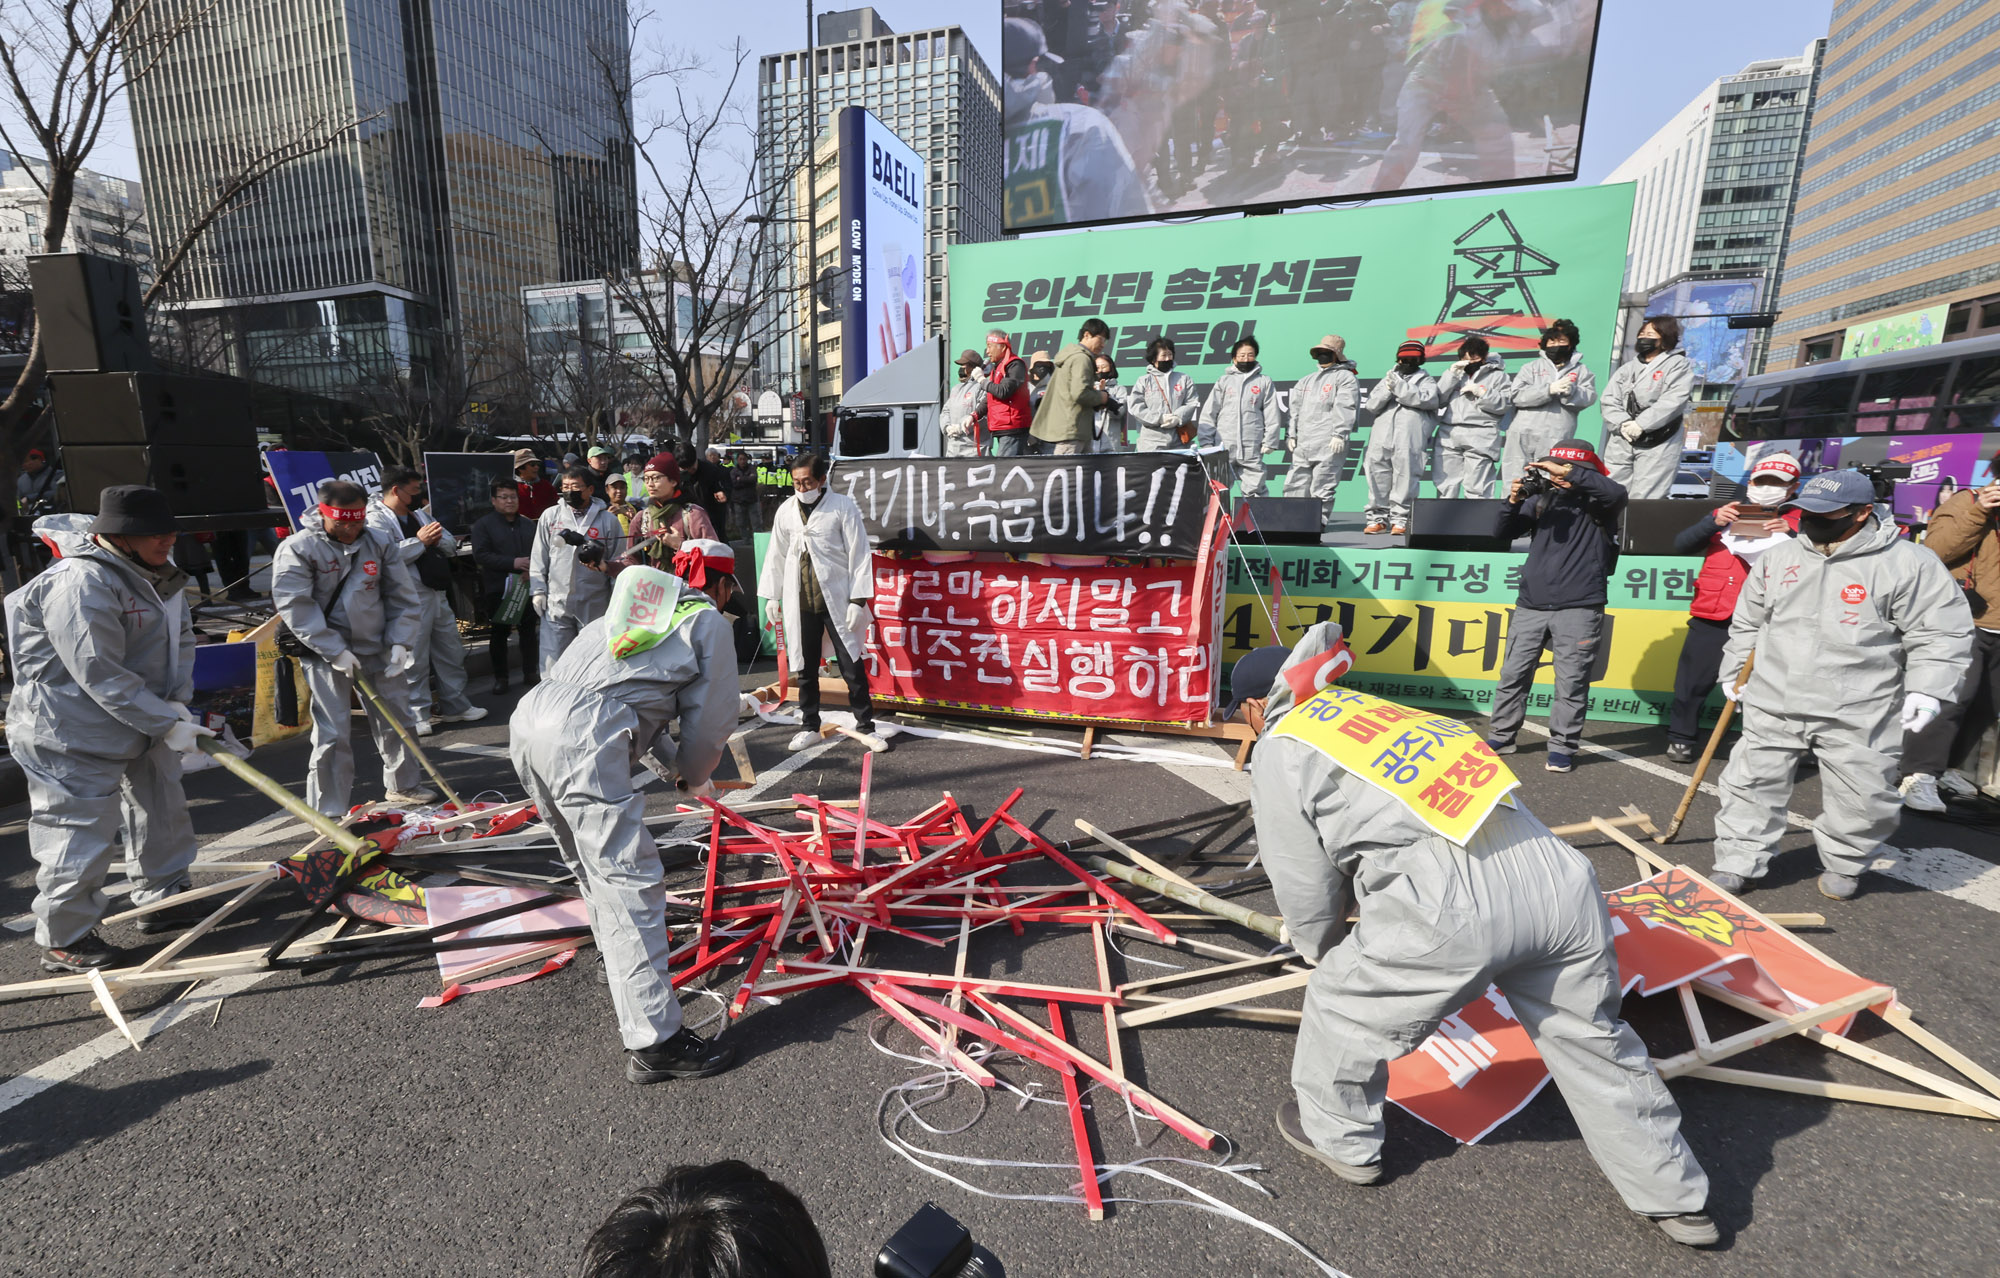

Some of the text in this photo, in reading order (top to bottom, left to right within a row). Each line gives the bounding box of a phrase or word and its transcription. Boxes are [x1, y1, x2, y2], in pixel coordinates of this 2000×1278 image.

[872, 141, 918, 209] BAELL
[852, 219, 861, 302] GLOW MODE ON
[982, 256, 1363, 323] 용인산단 송전선로
[1282, 558, 1342, 589] 대화
[1352, 560, 1414, 592] 기구
[1426, 563, 1491, 594] 구성
[1368, 682, 1435, 699] 재검토와
[1441, 684, 1492, 703] 초고압
[1603, 698, 1640, 714] 반대
